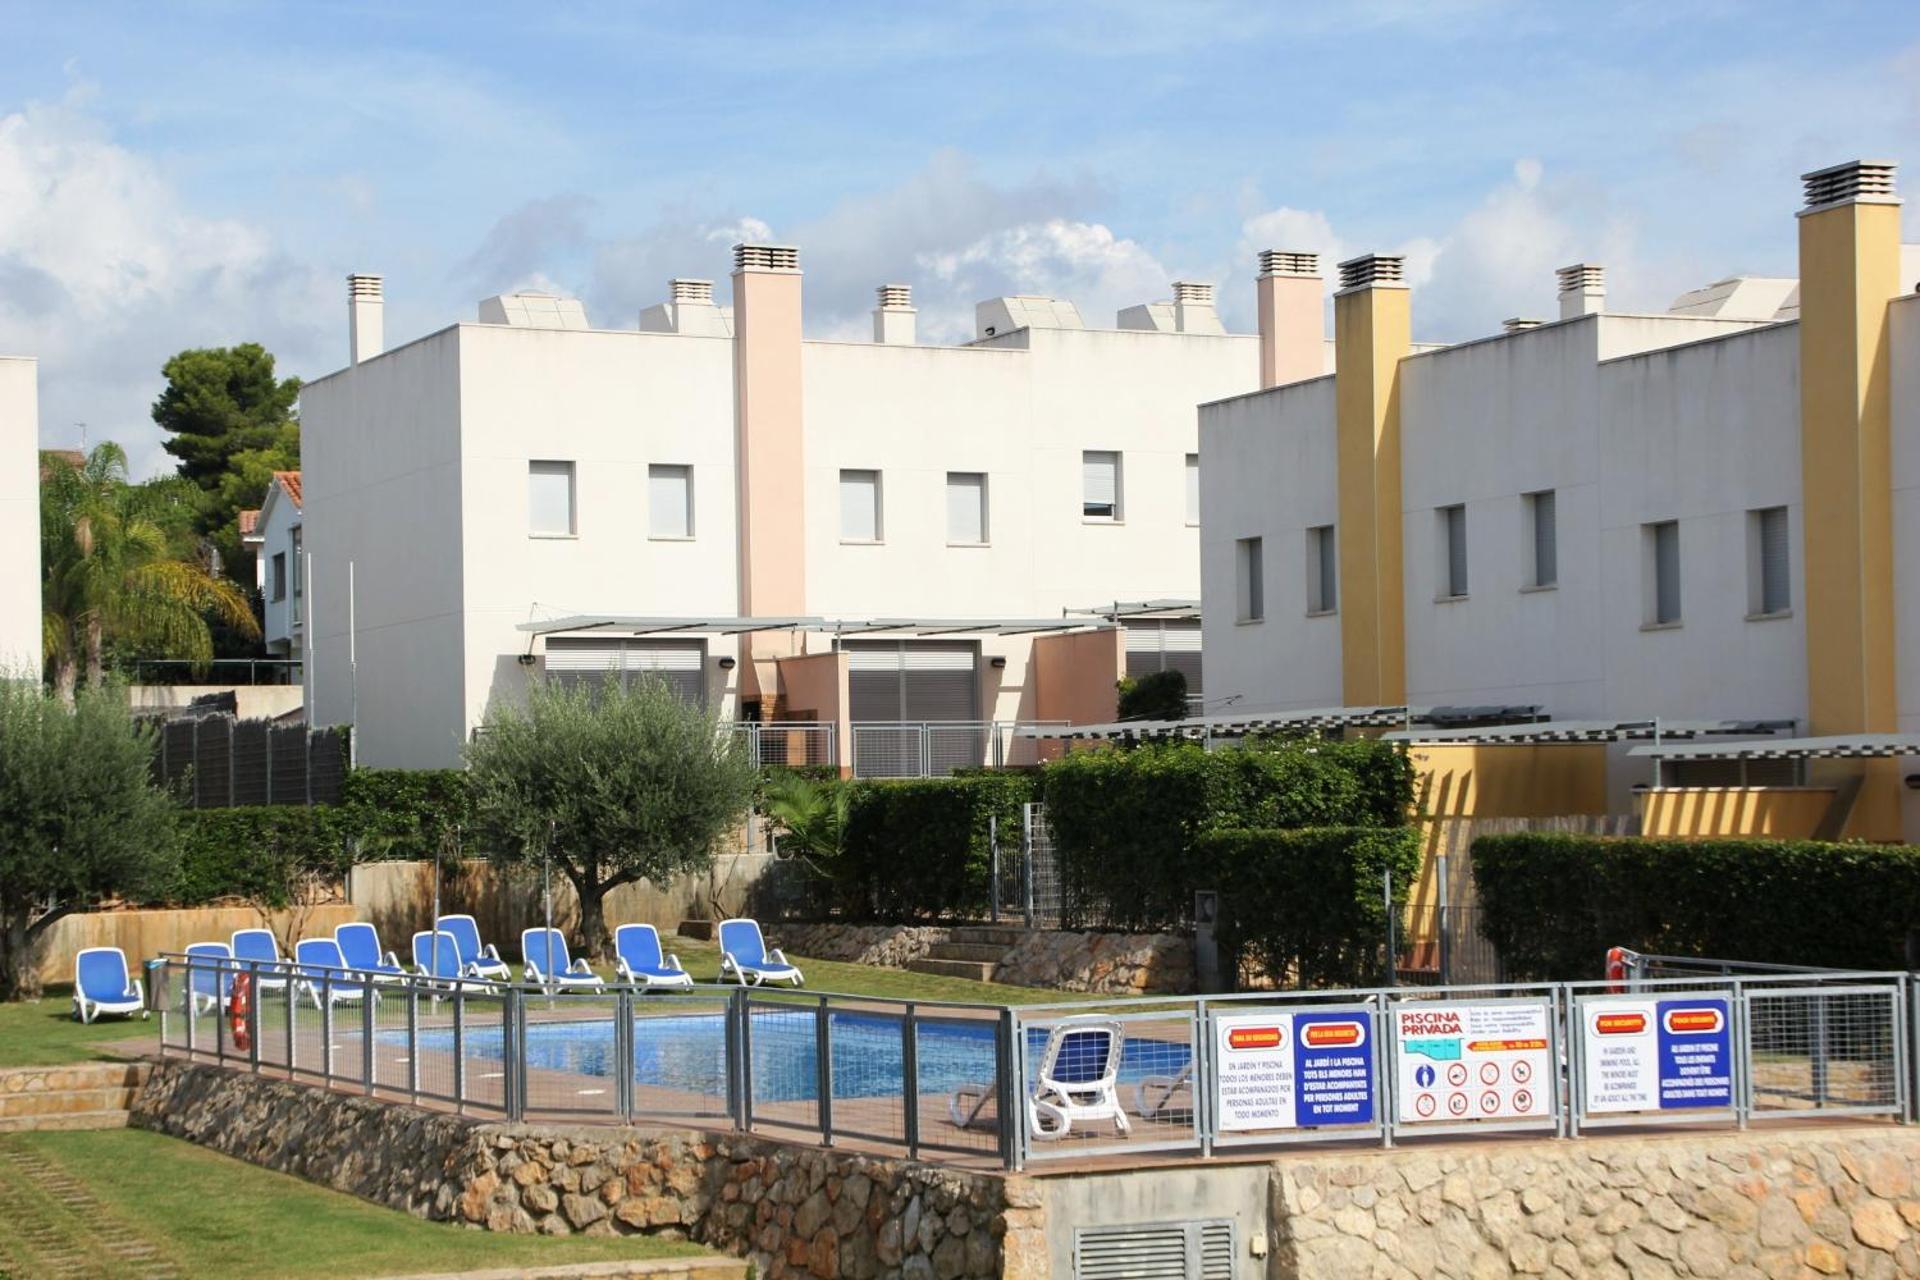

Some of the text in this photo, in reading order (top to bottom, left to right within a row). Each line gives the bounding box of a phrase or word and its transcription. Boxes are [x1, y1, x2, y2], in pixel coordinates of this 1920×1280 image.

[1401, 1012, 1460, 1024] PISCINA
[1402, 1023, 1463, 1035] PRIVADA
[1262, 1060, 1282, 1069] PISCINA
[1342, 1057, 1365, 1066] PISCINA
